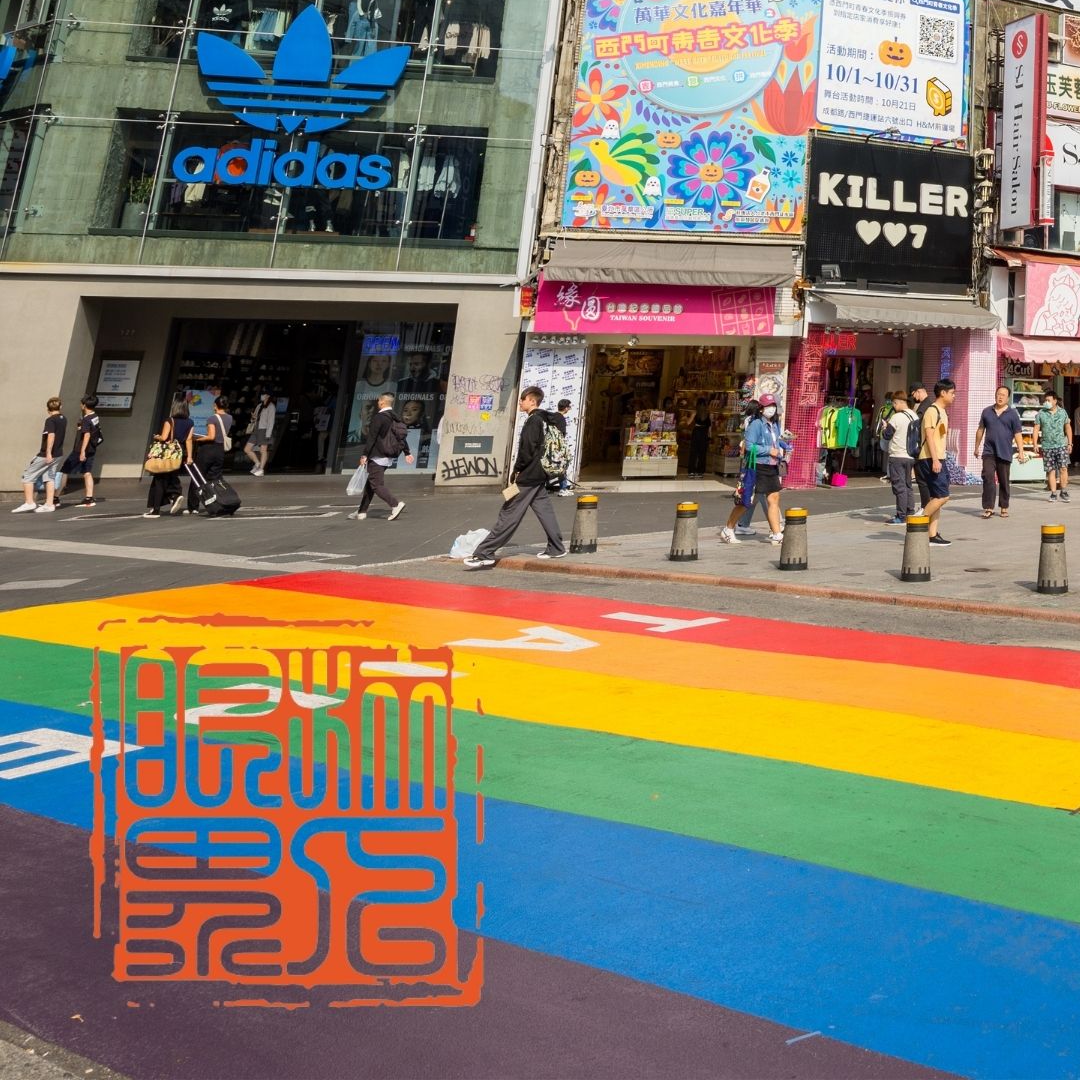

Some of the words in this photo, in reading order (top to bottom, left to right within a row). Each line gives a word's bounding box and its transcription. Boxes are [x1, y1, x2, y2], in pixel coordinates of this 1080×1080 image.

[594, 18, 800, 59] 西門町青春文化季
[826, 63, 918, 94] 10/1~10/31
[172, 138, 391, 191] adidas
[818, 172, 968, 218] KILLER
[609, 314, 637, 322] TAIWAN
[639, 314, 676, 322] SOUVENIR
